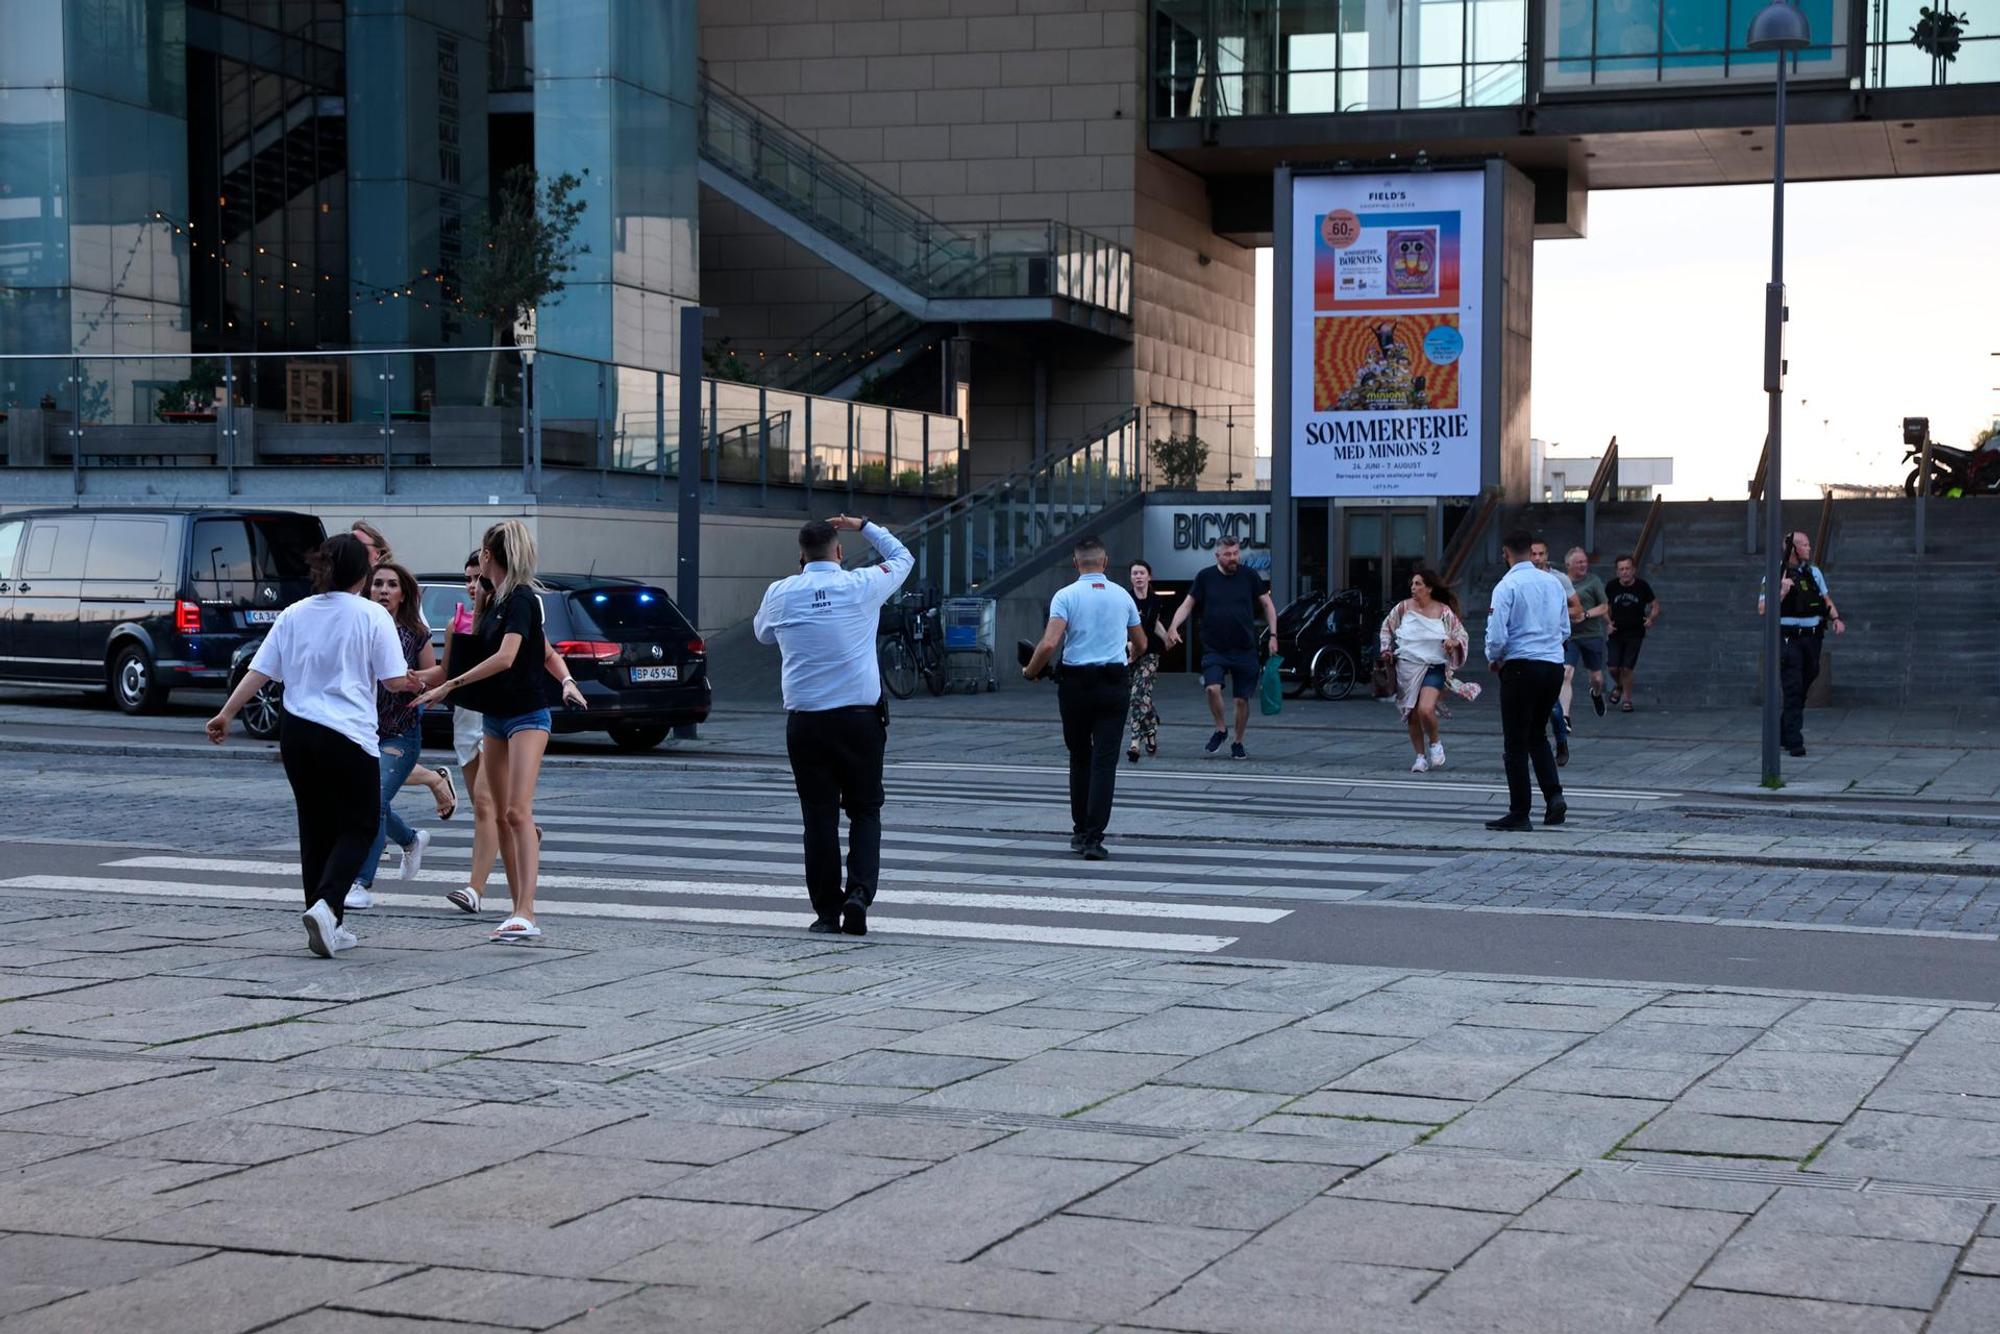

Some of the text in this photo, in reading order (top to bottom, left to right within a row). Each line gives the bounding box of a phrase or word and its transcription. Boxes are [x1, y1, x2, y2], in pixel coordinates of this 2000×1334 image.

[1368, 191, 1406, 201] FIELD'S
[1306, 415, 1468, 445] SOMMERFERIE
[1334, 441, 1441, 460] MED MINIONS 2
[1393, 461, 1421, 469] AUGUST
[650, 667, 660, 678] 45
[661, 667, 677, 678] 942
